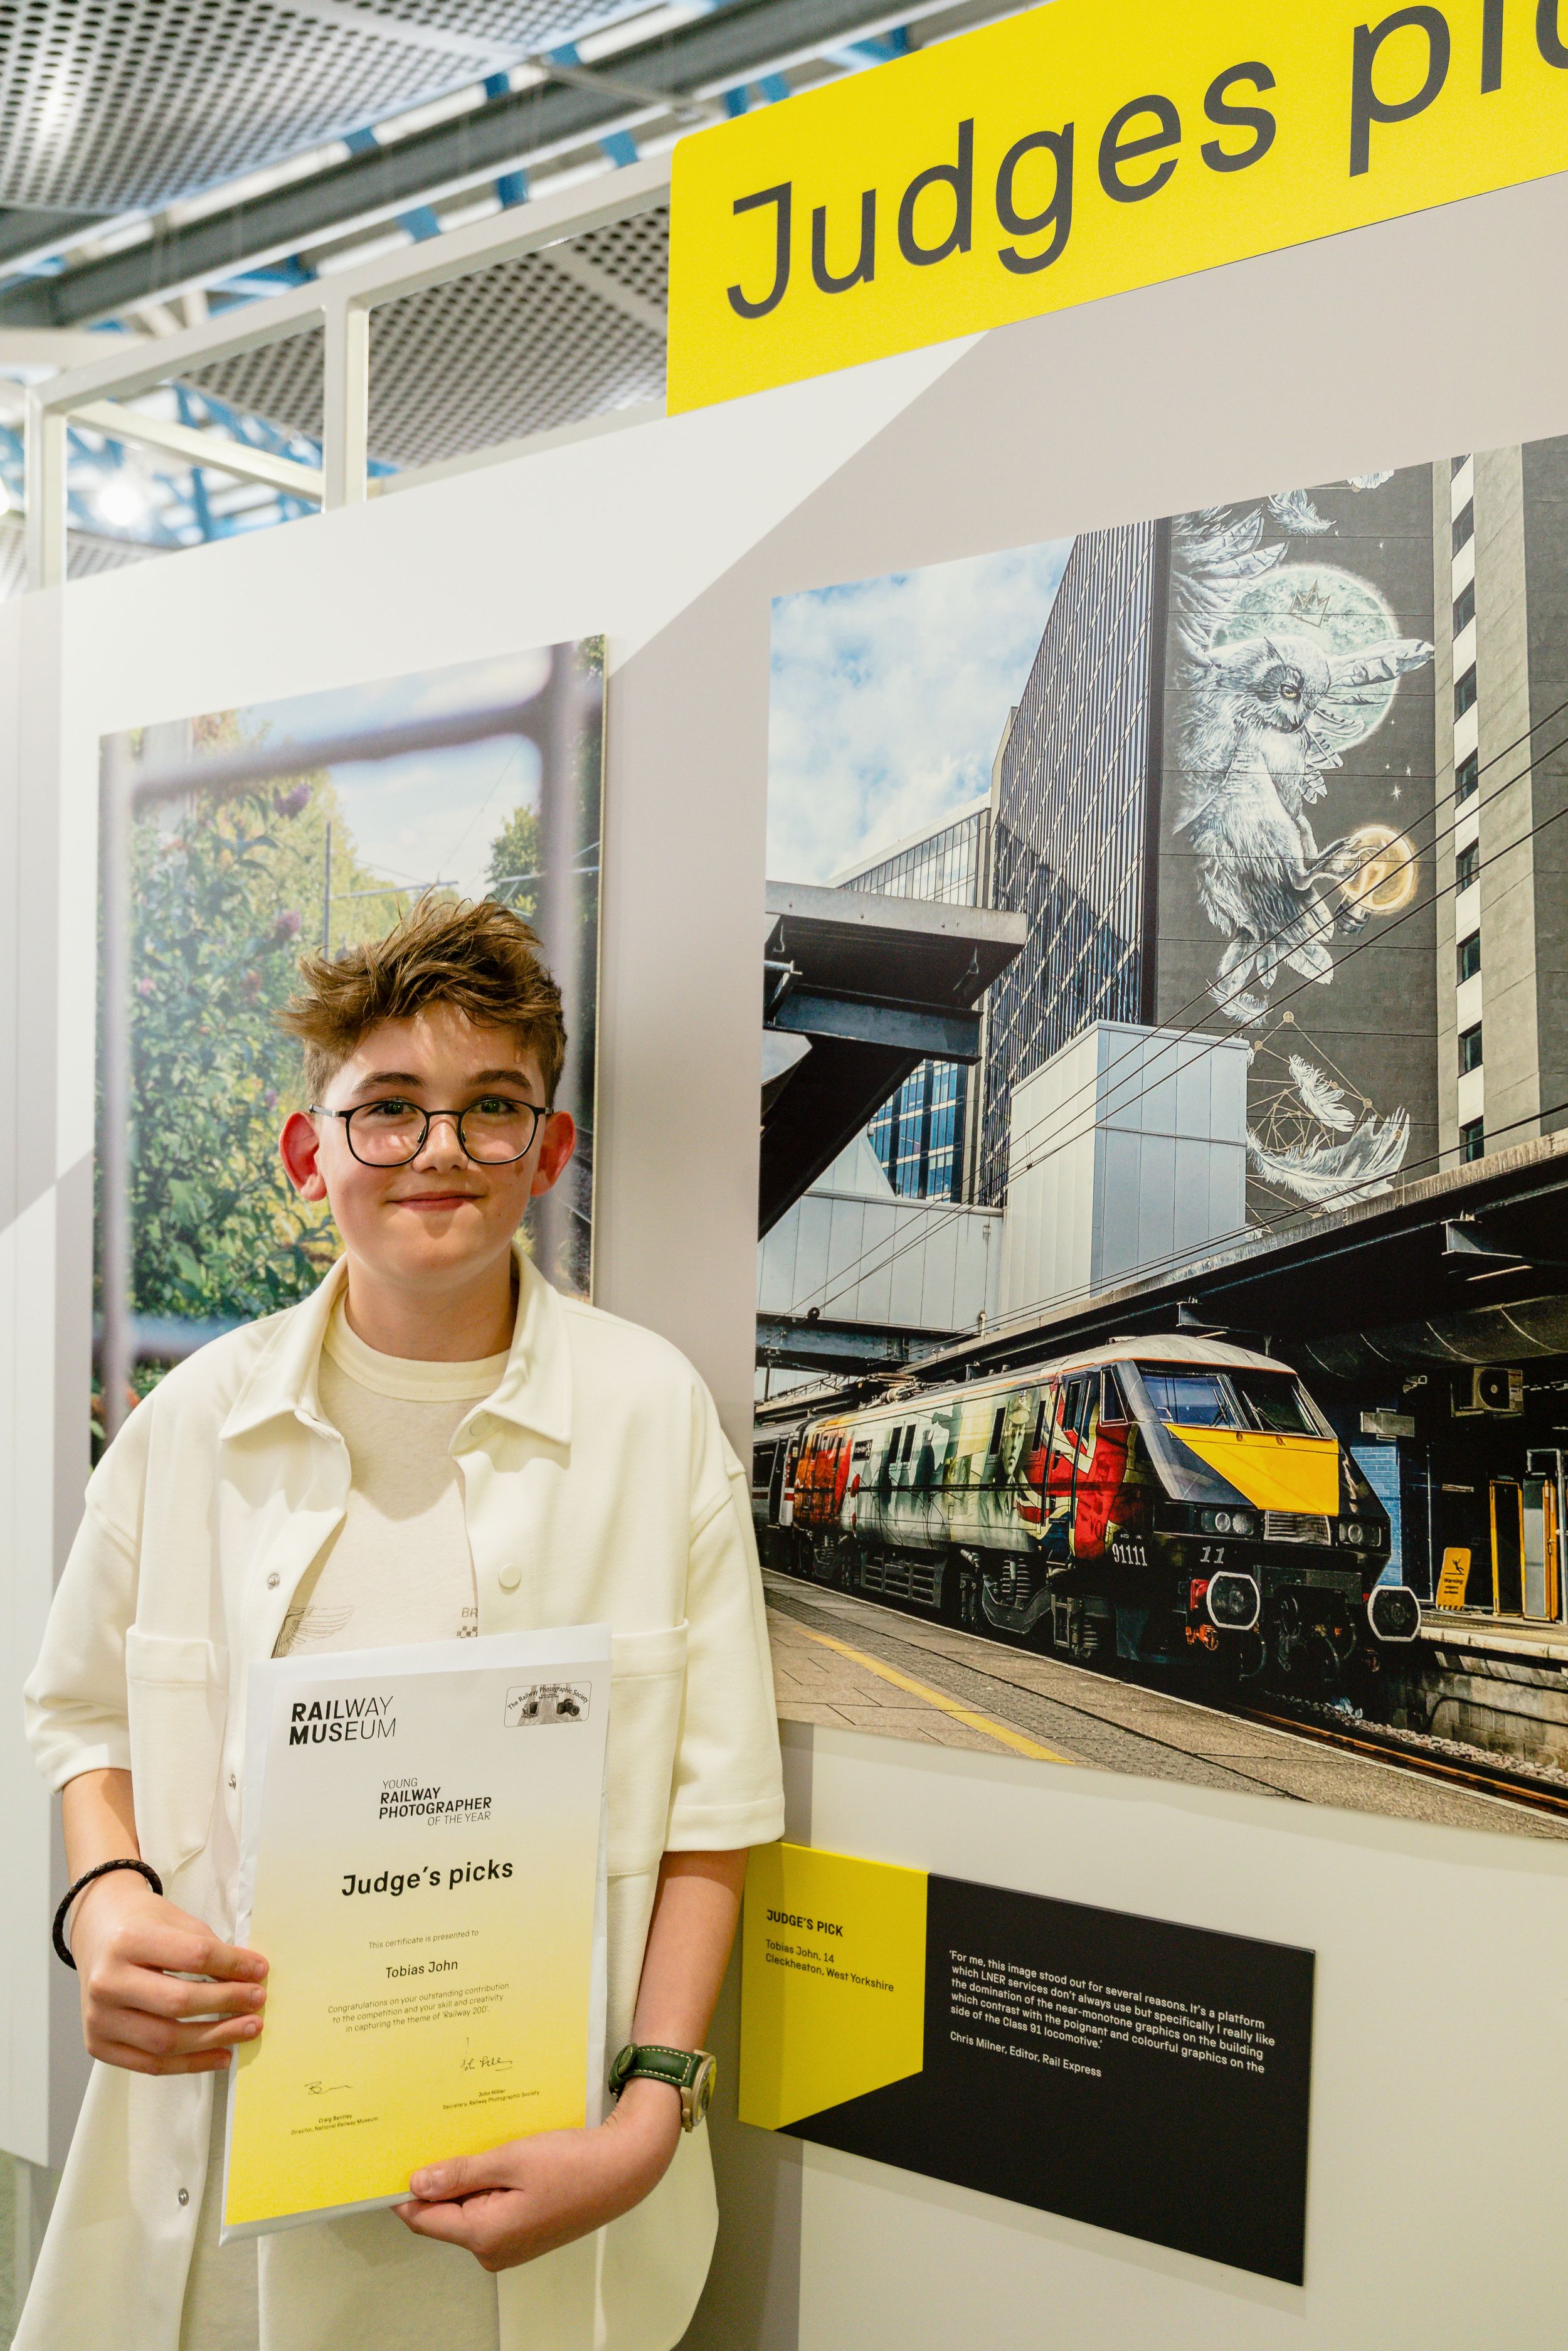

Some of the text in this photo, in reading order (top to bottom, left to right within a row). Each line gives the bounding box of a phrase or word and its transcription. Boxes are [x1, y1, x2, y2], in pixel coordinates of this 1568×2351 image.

[726, 61, 1277, 319] Judges
[1112, 1543, 1147, 1566] 91111
[1200, 1546, 1224, 1564] 11
[292, 1696, 393, 1722] RAILWAY
[507, 1701, 519, 1710] The
[519, 1690, 538, 1702] Railway
[573, 1690, 588, 1704] Society
[289, 1718, 396, 1746] MUSEUM
[381, 1787, 441, 1804] RAILWAY
[383, 1778, 418, 1789] YOUNG
[379, 1796, 492, 1819] PHOTOGRAPHER
[428, 1812, 491, 1826] OF THE YEAR
[342, 1859, 513, 1897] Judge's picks
[766, 1909, 843, 1937] JUDGE'S PICK
[385, 1936, 423, 1948] certificate
[433, 1930, 470, 1941] presented
[766, 1939, 834, 1963] Tobias John, 14
[386, 1960, 458, 1978] Tobias John
[766, 1953, 894, 1992] Cleckheaton, West Yorkshire
[328, 2000, 388, 2014] Congratulations
[401, 1995, 417, 2005] your
[420, 1989, 463, 2001] outstanding
[465, 1983, 509, 1995] contribution
[949, 1950, 1265, 2029] 'For me, this image stood out for several reasons. It's a platform
[357, 2009, 401, 2020] competition
[404, 2005, 418, 2014] and
[420, 2004, 436, 2013] your
[438, 2001, 452, 2009] skill
[454, 1998, 467, 2007] and
[469, 1994, 504, 2004] creativity
[952, 1966, 1275, 2046] which LNER services don't always use but specifically I really like
[354, 2020, 391, 2031] capturing
[407, 2014, 431, 2024] theme
[951, 1978, 1263, 2061] the domination of the near-monotone graphics on the building
[951, 2006, 1103, 2049] side of the Class 91 locomotive.'
[951, 1993, 1265, 2074] which contrast with the poignant and colourful graphics on the
[950, 2031, 1102, 2077] Chris Milner, Editor, Rail Express
[489, 2093, 521, 2102] Photographic
[315, 2123, 336, 2131] National
